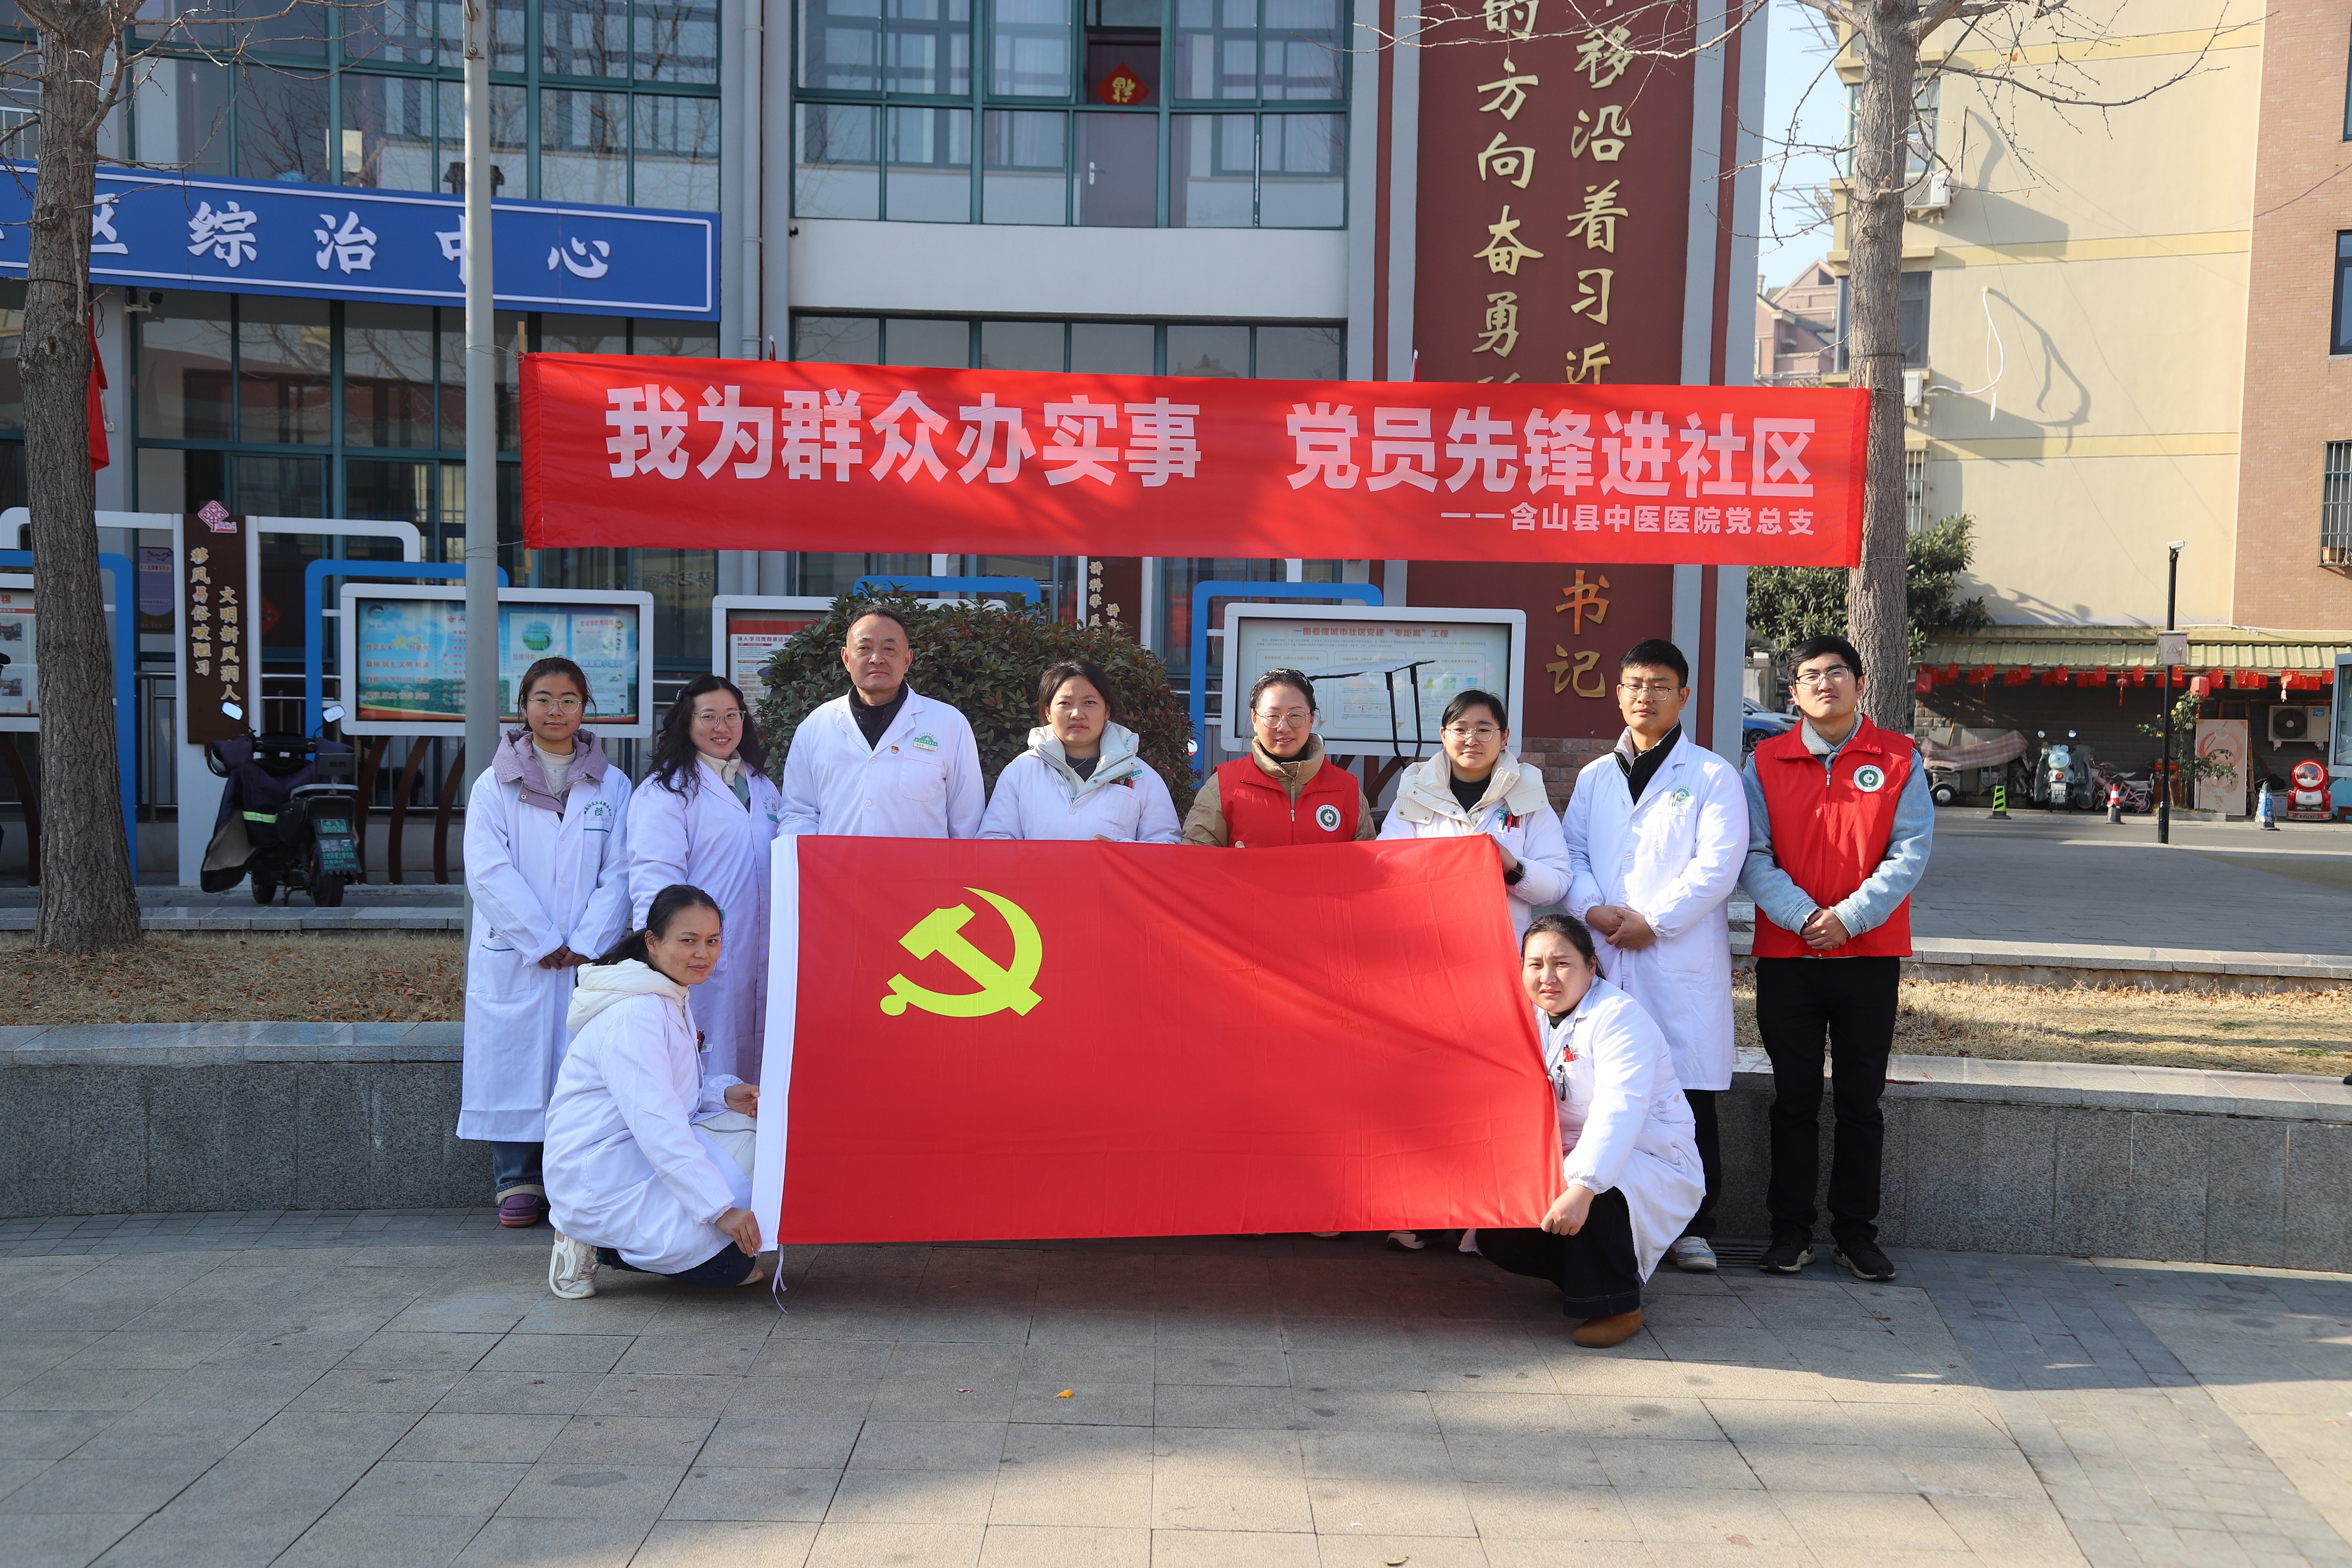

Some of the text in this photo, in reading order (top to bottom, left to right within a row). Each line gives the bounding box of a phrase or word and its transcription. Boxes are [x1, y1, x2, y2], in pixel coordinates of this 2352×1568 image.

[1472, 0, 1544, 384] 的方向奋勇
[1561, 0, 1633, 384] 移沿着习近
[604, 382, 1815, 498] 我为群众办实事 党员先锋进社区
[190, 547, 212, 676] 移风易俗破陋习
[219, 586, 241, 707] 文明新风润人
[1089, 561, 1104, 636] 讲科学反
